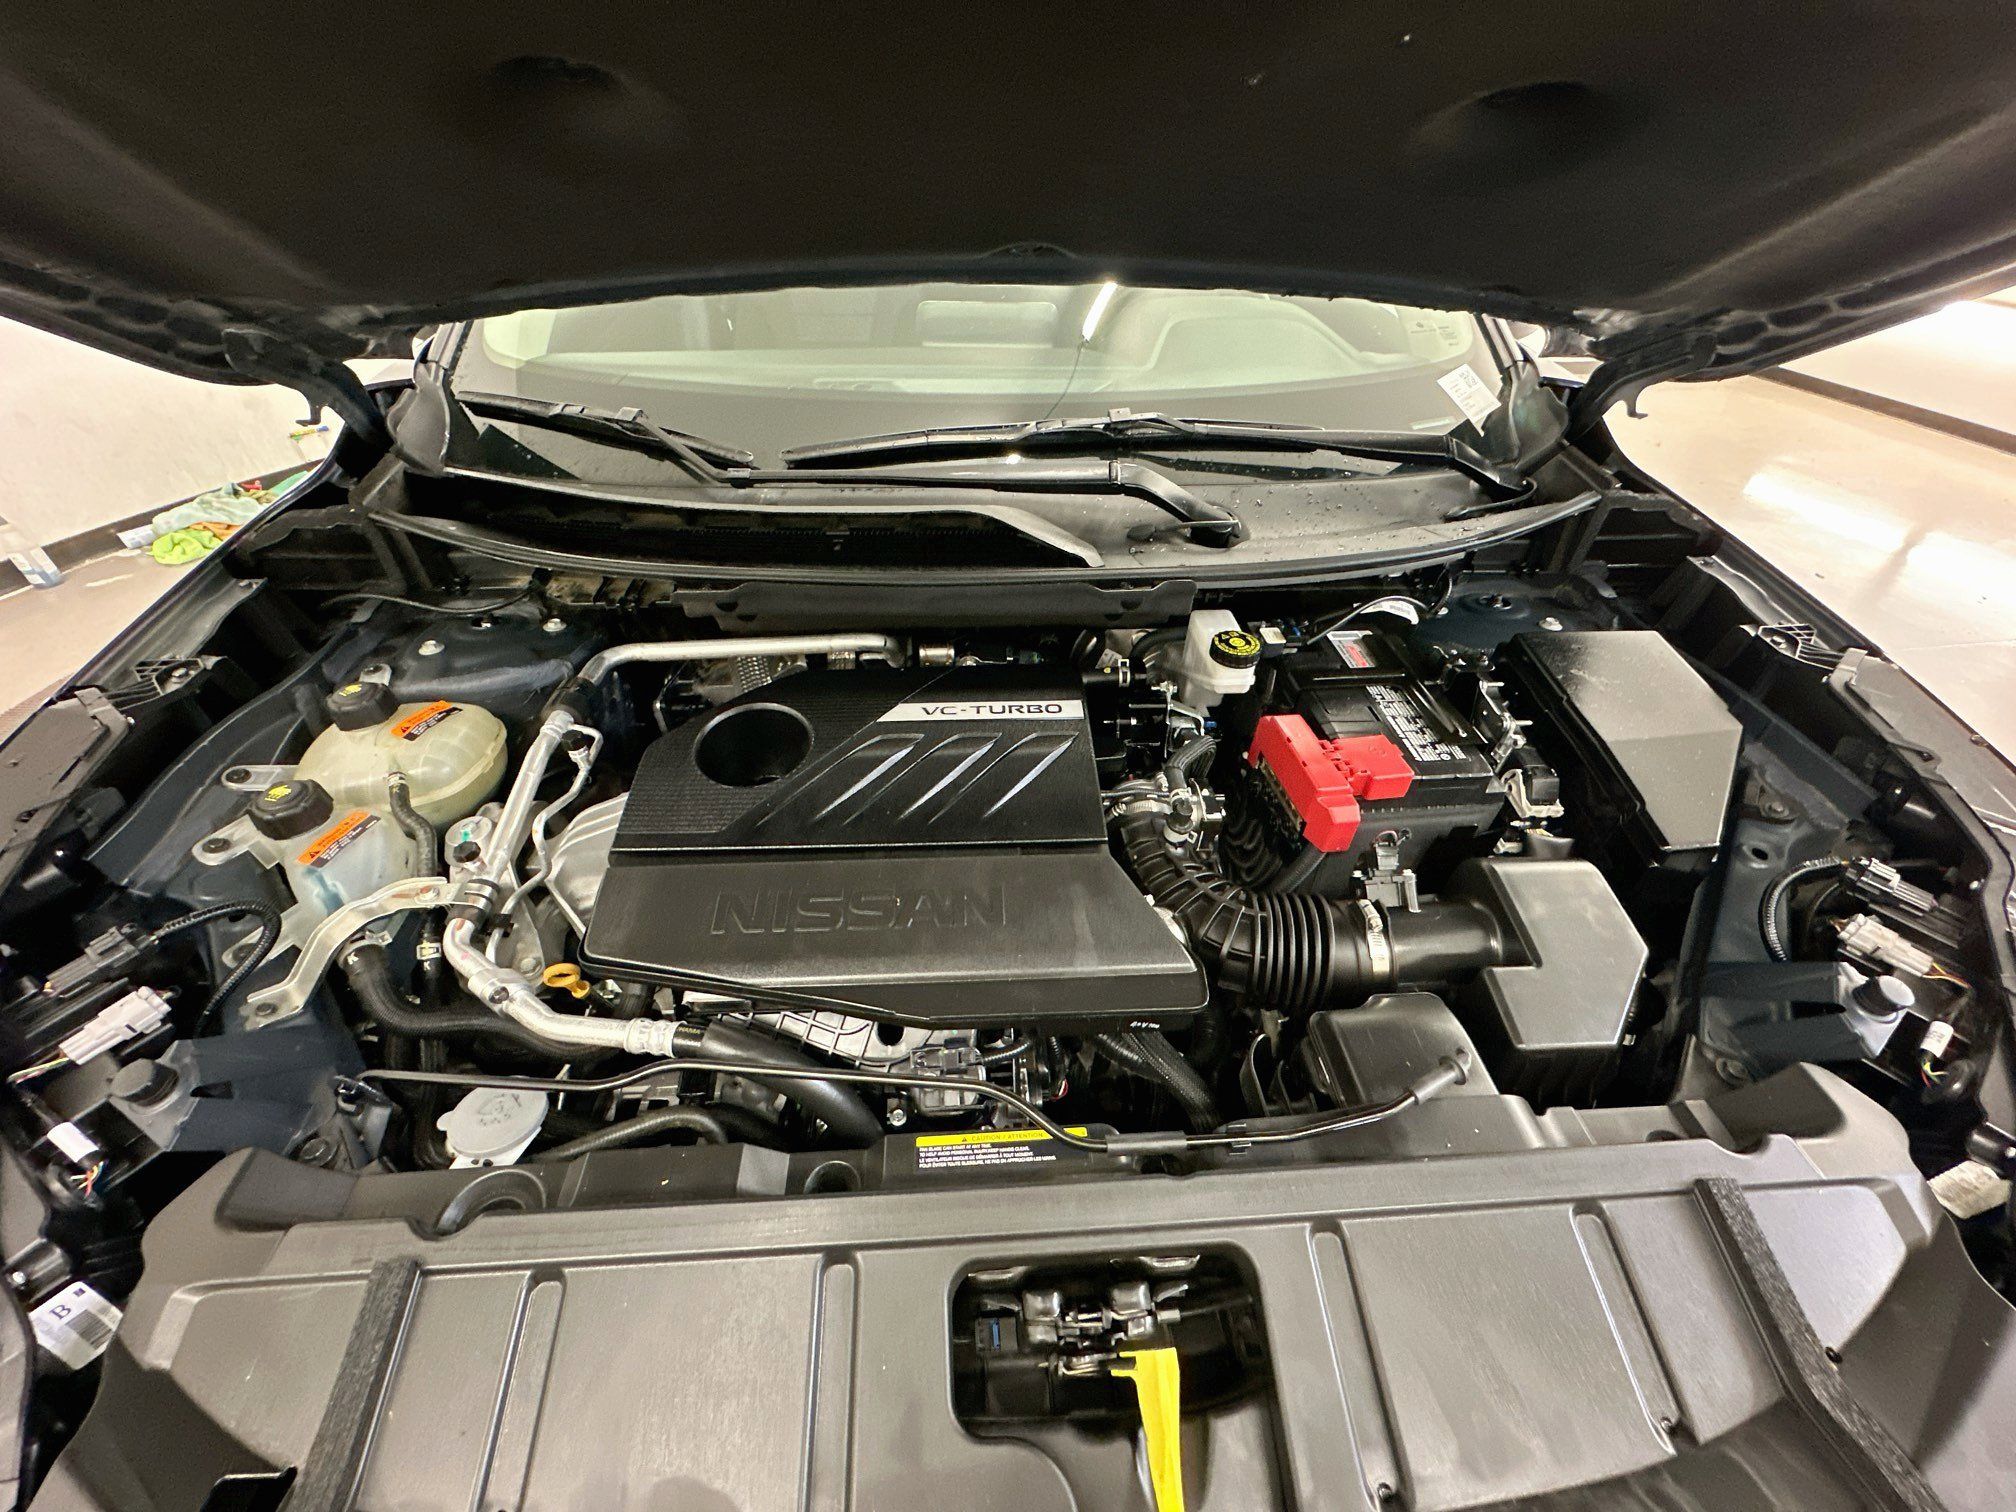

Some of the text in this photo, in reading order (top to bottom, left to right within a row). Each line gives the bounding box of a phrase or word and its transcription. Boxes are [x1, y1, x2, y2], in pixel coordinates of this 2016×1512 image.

[921, 703, 1063, 716] VC-TURBO
[710, 886, 1006, 934] NISSAN
[423, 961, 431, 971] K
[1008, 1132, 1043, 1140] ATTENTION
[49, 1304, 71, 1320] B
